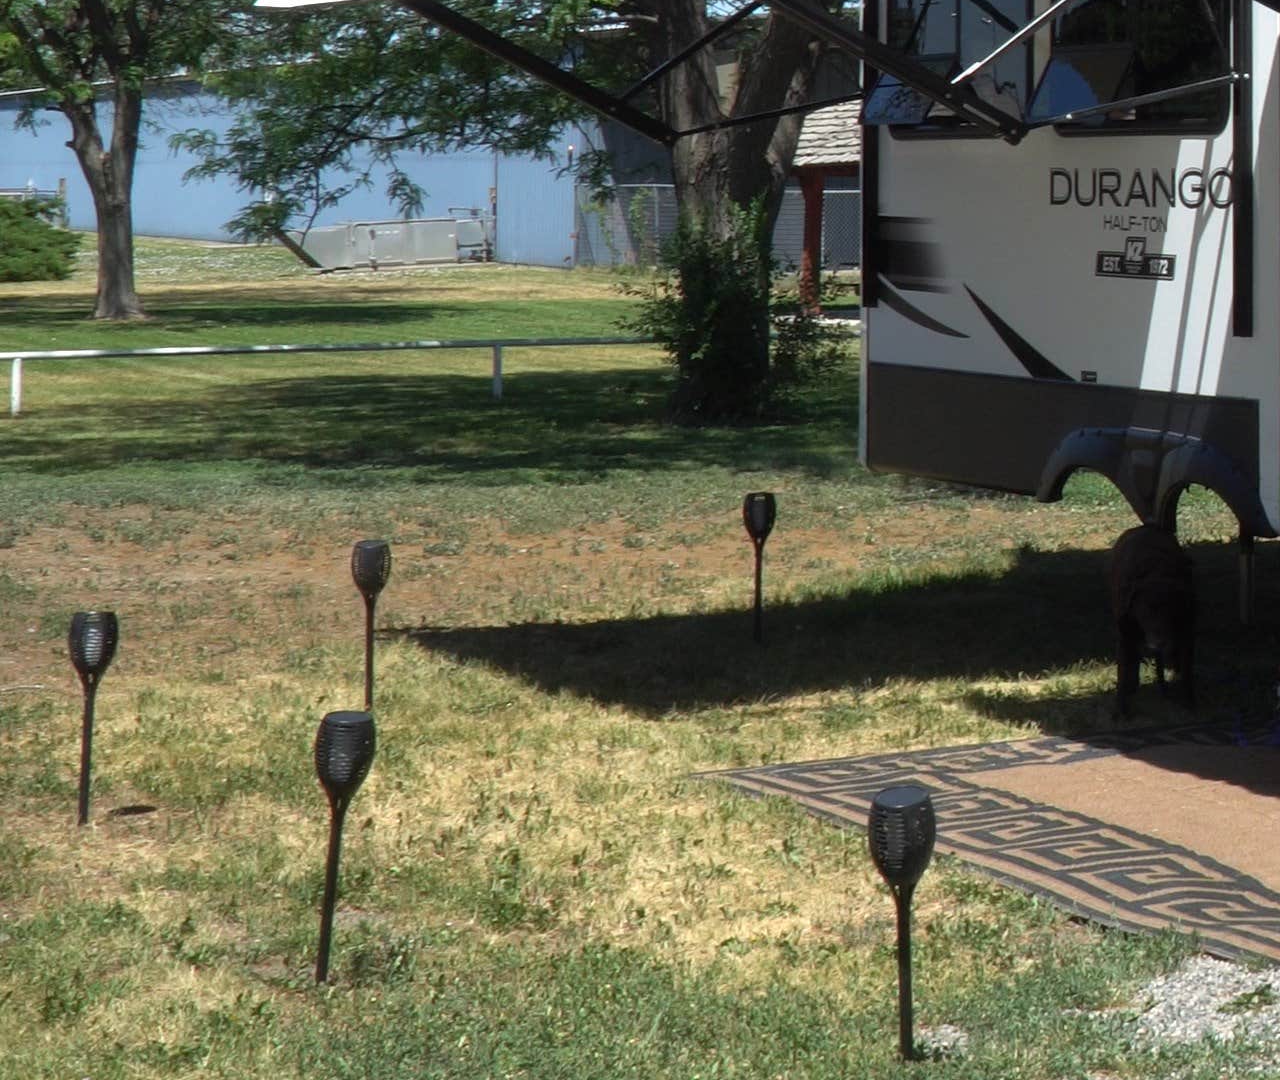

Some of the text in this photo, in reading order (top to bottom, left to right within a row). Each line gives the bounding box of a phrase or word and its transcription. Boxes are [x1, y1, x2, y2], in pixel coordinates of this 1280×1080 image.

[1050, 167, 1234, 209] DURANGO
[1103, 215, 1168, 233] HALF-TON
[1149, 258, 1169, 275] 1972
